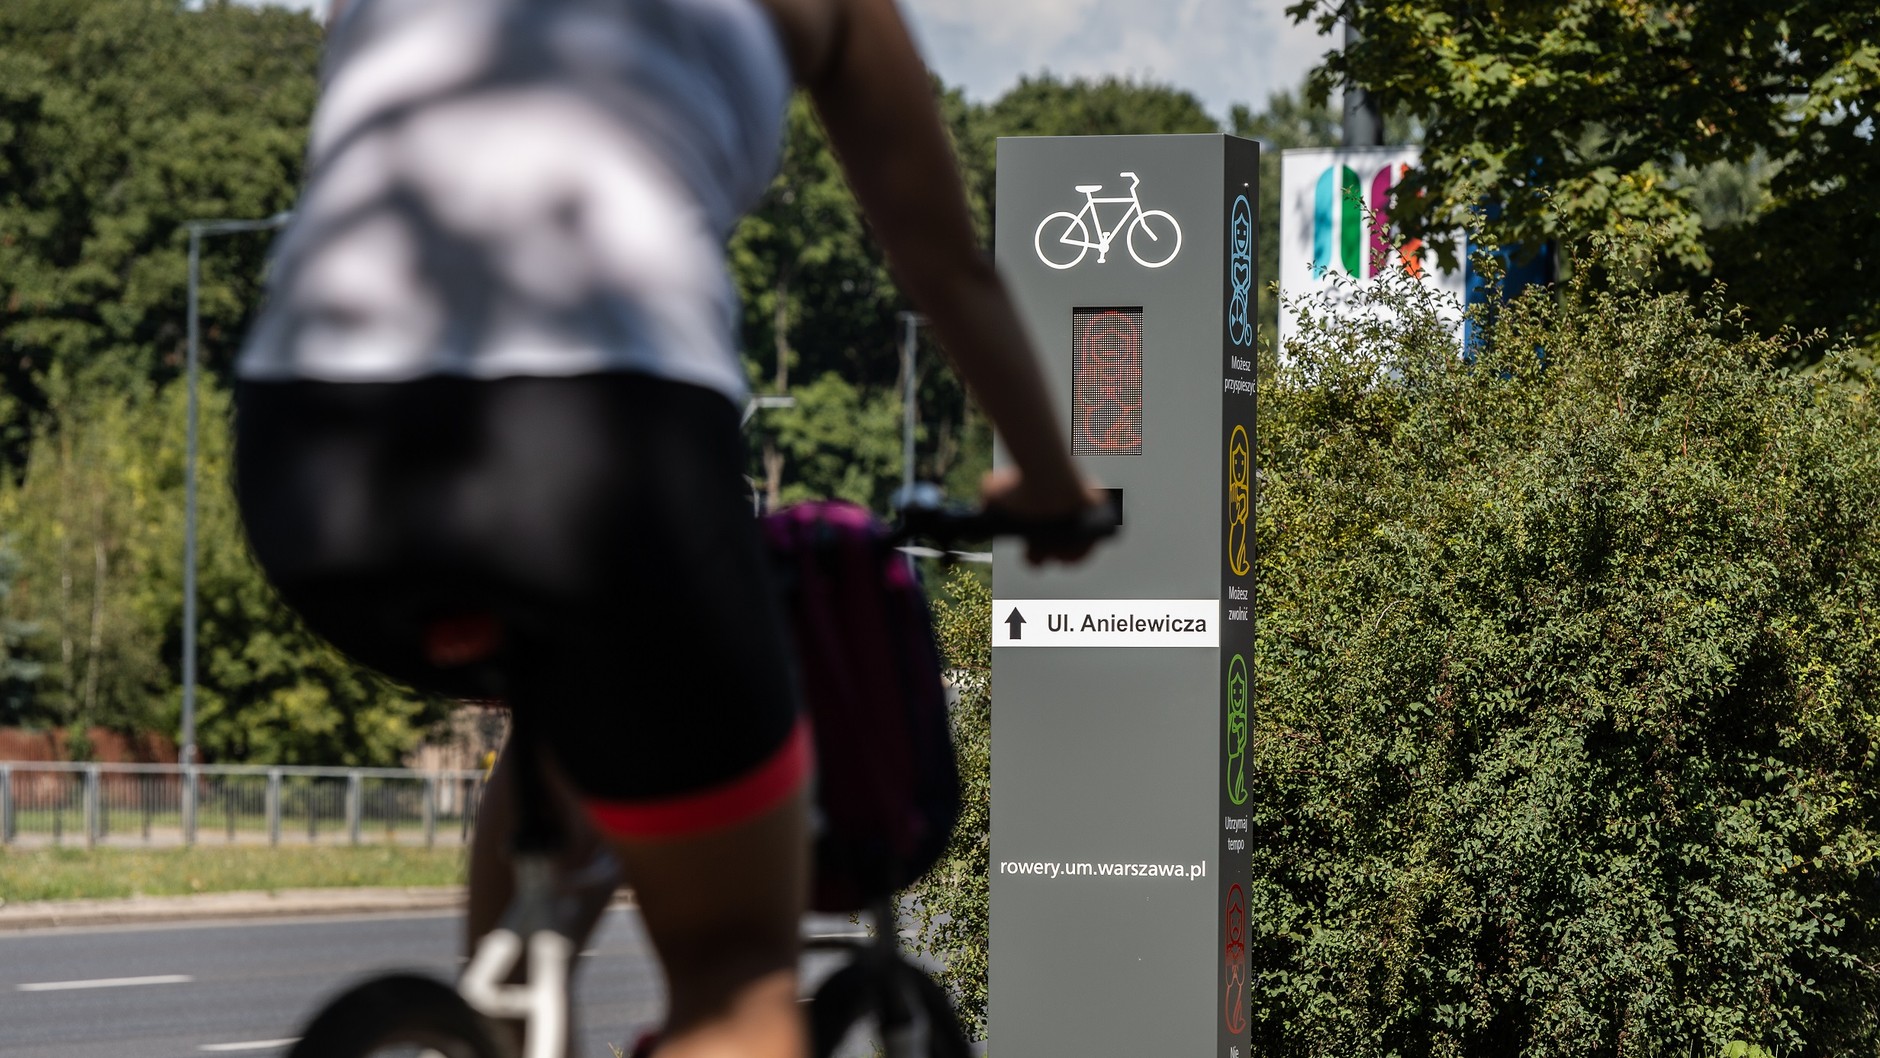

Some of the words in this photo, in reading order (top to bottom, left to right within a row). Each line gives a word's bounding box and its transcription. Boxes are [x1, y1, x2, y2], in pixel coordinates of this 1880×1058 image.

[1231, 355, 1251, 372] Możesz
[1224, 377, 1256, 396] przyspieszyć
[1228, 585, 1249, 600] Możesz
[1228, 606, 1249, 621] zwolnić
[1047, 614, 1074, 632] Ul.
[1080, 614, 1207, 632] Anielewicza
[1224, 814, 1248, 833] Utrzymaj
[1227, 837, 1245, 854] tempo
[1000, 860, 1206, 881] rowery.um.warszawa.pl
